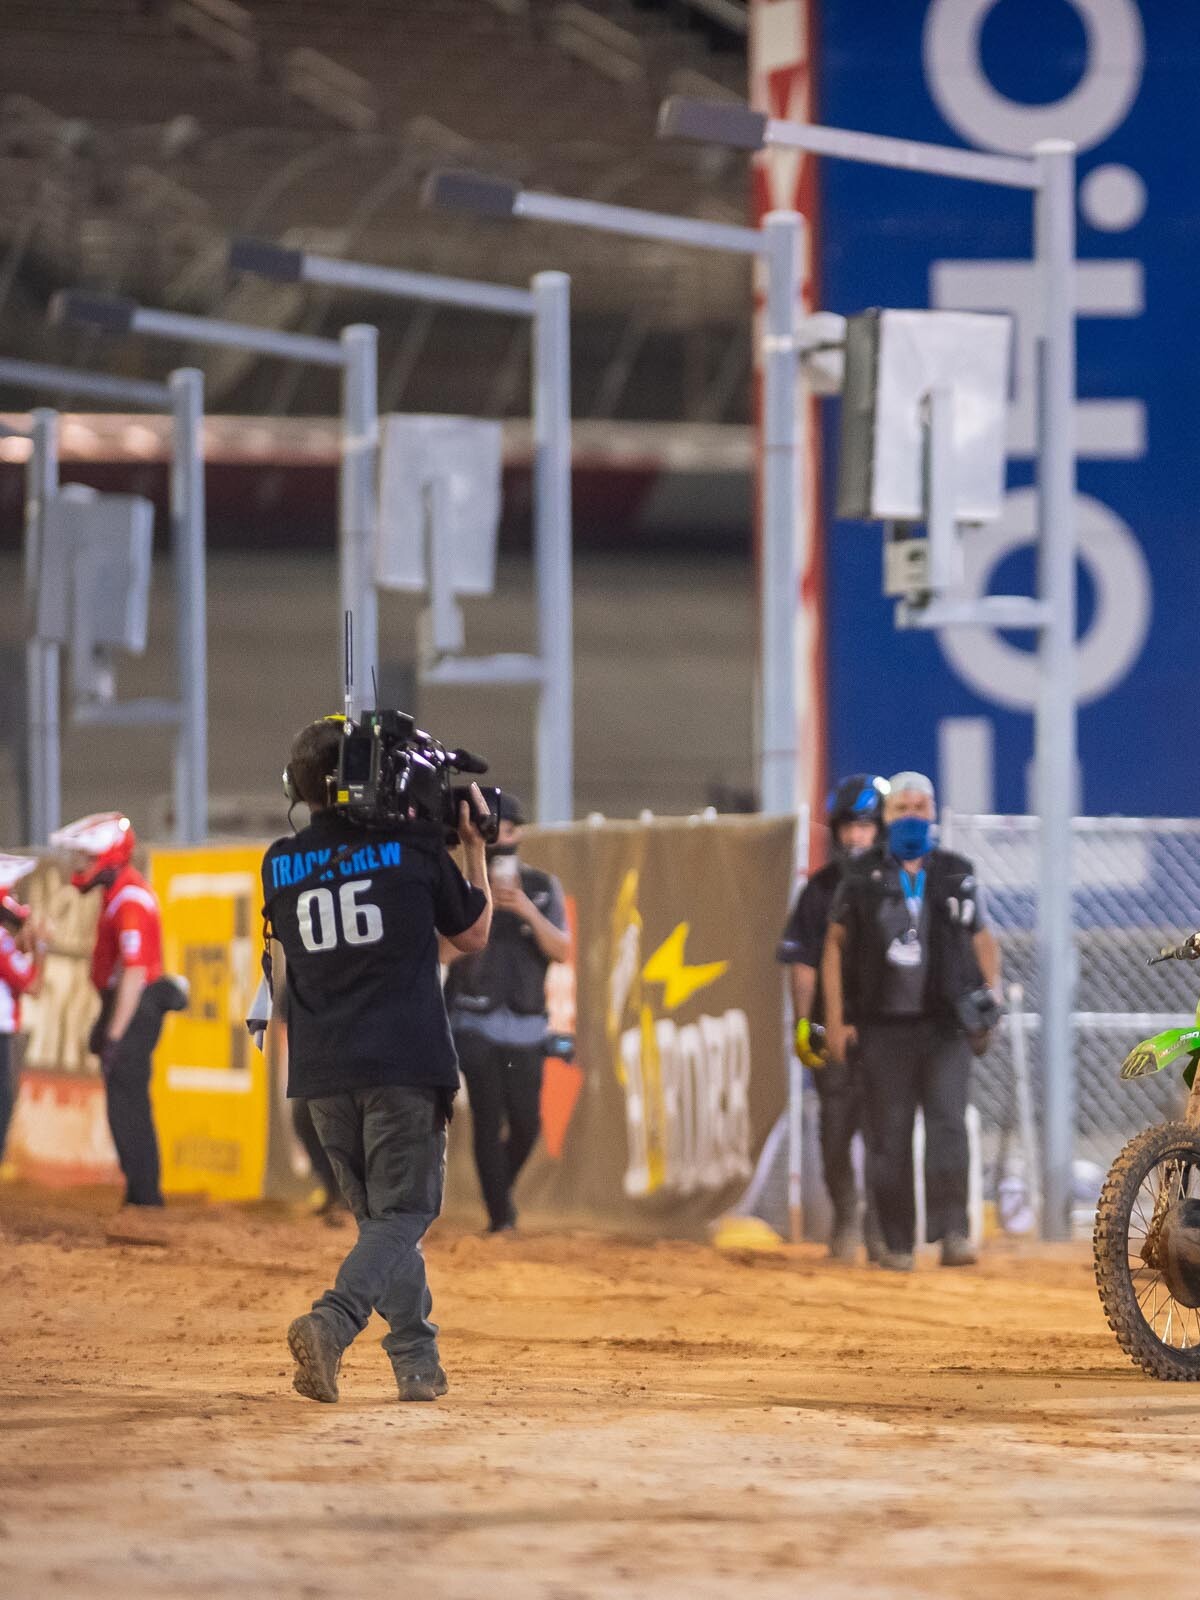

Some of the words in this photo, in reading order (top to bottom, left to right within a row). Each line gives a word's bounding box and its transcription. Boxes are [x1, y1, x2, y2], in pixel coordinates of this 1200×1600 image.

[271, 848, 336, 889] TRACK
[338, 842, 401, 877] CREW
[297, 879, 384, 952] 06
